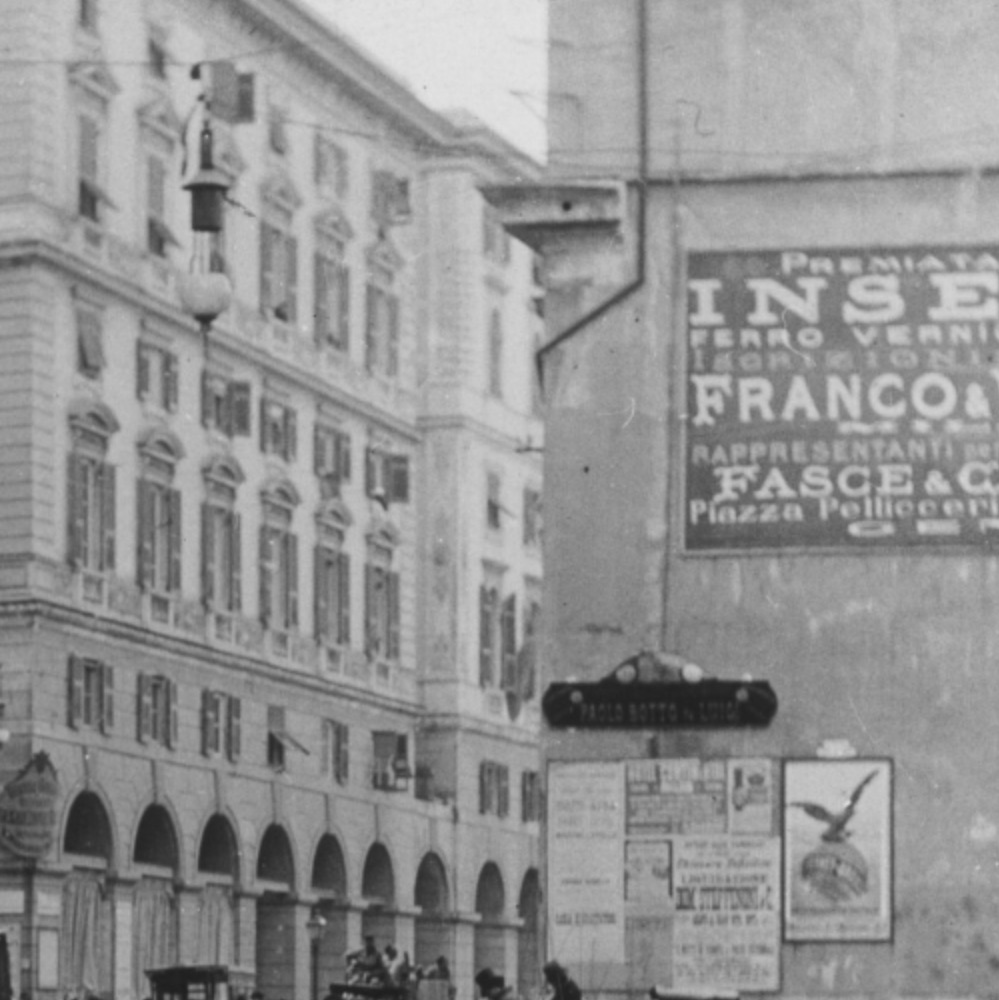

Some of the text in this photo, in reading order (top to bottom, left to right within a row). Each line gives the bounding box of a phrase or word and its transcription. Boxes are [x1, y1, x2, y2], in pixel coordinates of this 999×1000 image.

[689, 273, 999, 325] INSE
[690, 323, 999, 349] FERRO VERNI
[691, 371, 958, 427] FRANCO
[692, 438, 953, 465] RAPPRESENTANTI
[713, 464, 914, 503] FASCE
[924, 469, 953, 496] &
[690, 499, 805, 526] Piazza
